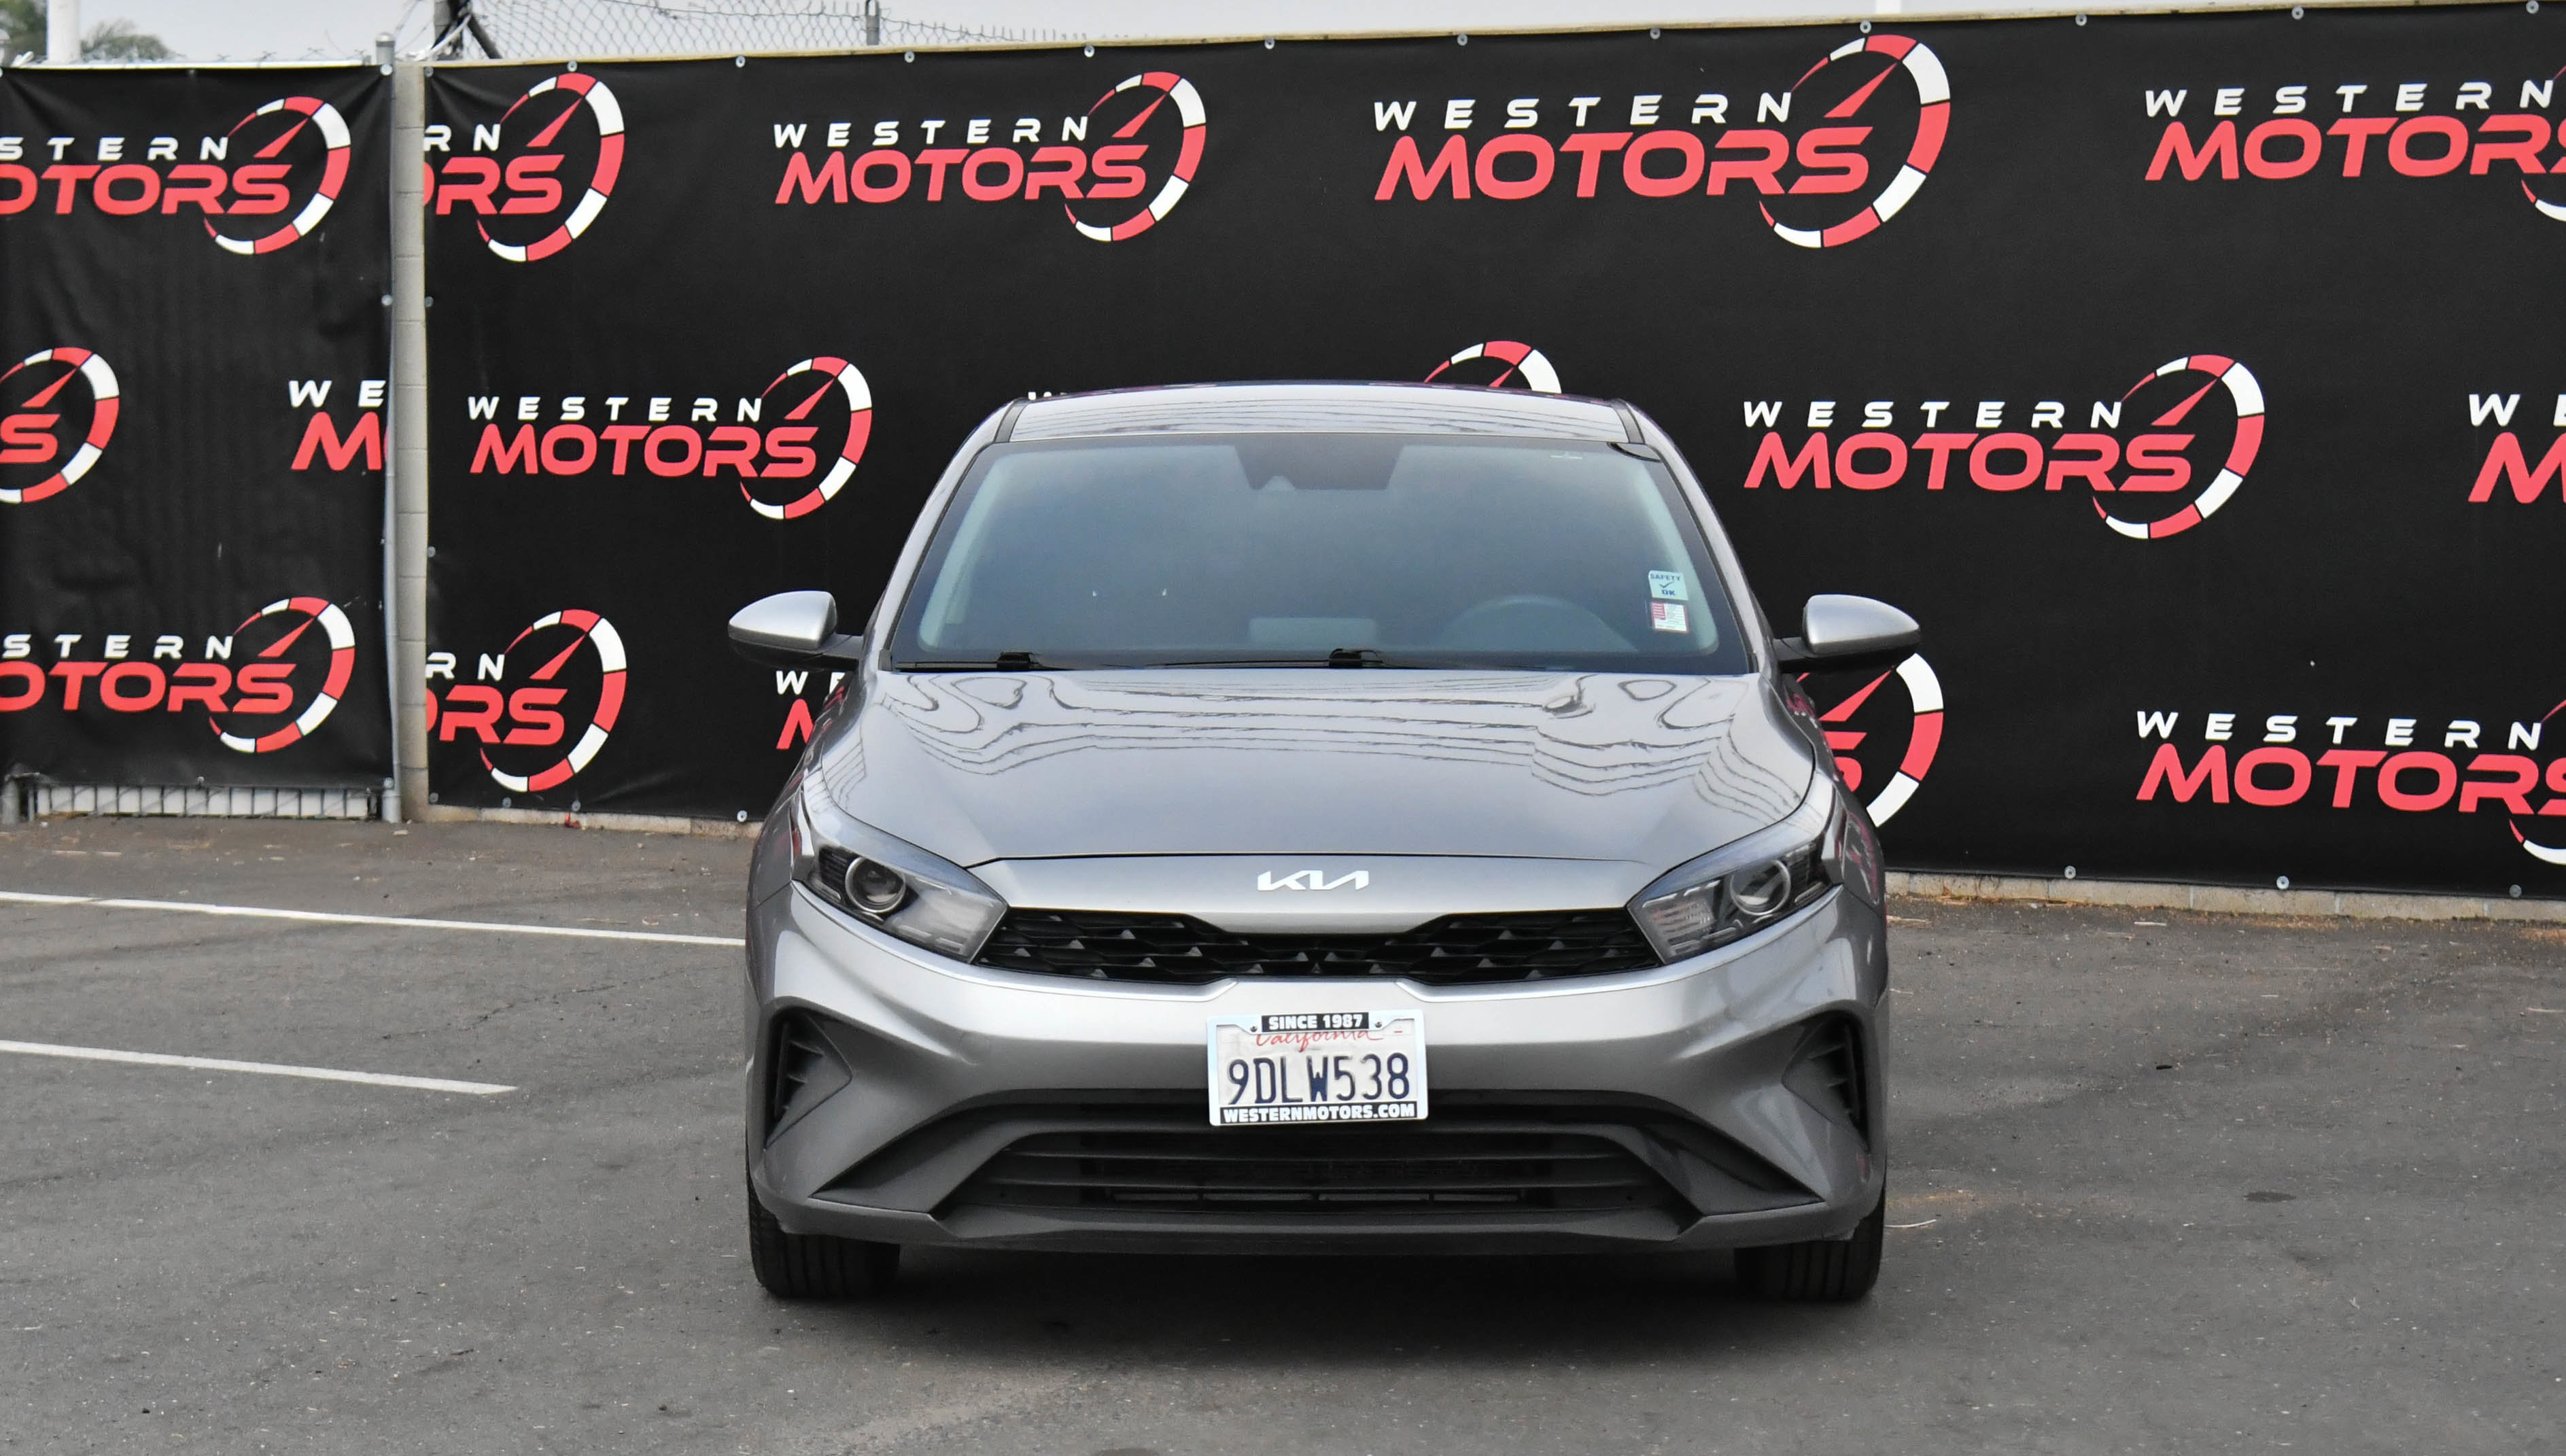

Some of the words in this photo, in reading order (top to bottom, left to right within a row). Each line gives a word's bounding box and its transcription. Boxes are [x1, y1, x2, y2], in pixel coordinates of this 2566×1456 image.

[1374, 92, 1792, 132] WESTERN
[2145, 80, 2554, 118] WESTERN
[773, 116, 1089, 149] WESTERN
[2144, 114, 2566, 182] MOTOR
[774, 144, 1149, 205] MOTORS
[1374, 126, 1874, 203] MOTORS
[467, 396, 763, 423] WESTERN
[1743, 400, 2123, 429] WESTERN
[469, 423, 819, 479] MOTORS
[1743, 430, 2196, 493] MOTORS
[1650, 573, 1681, 582] SAFETY
[2136, 710, 2542, 751] WESTERN
[1258, 870, 1370, 890] KIA
[1268, 1015, 1318, 1030] SINCE
[1322, 1013, 1363, 1029] 1987
[1228, 1052, 1410, 1105] 9DLW538
[1223, 1104, 1415, 1123] WESTERNMOTORS.COM
